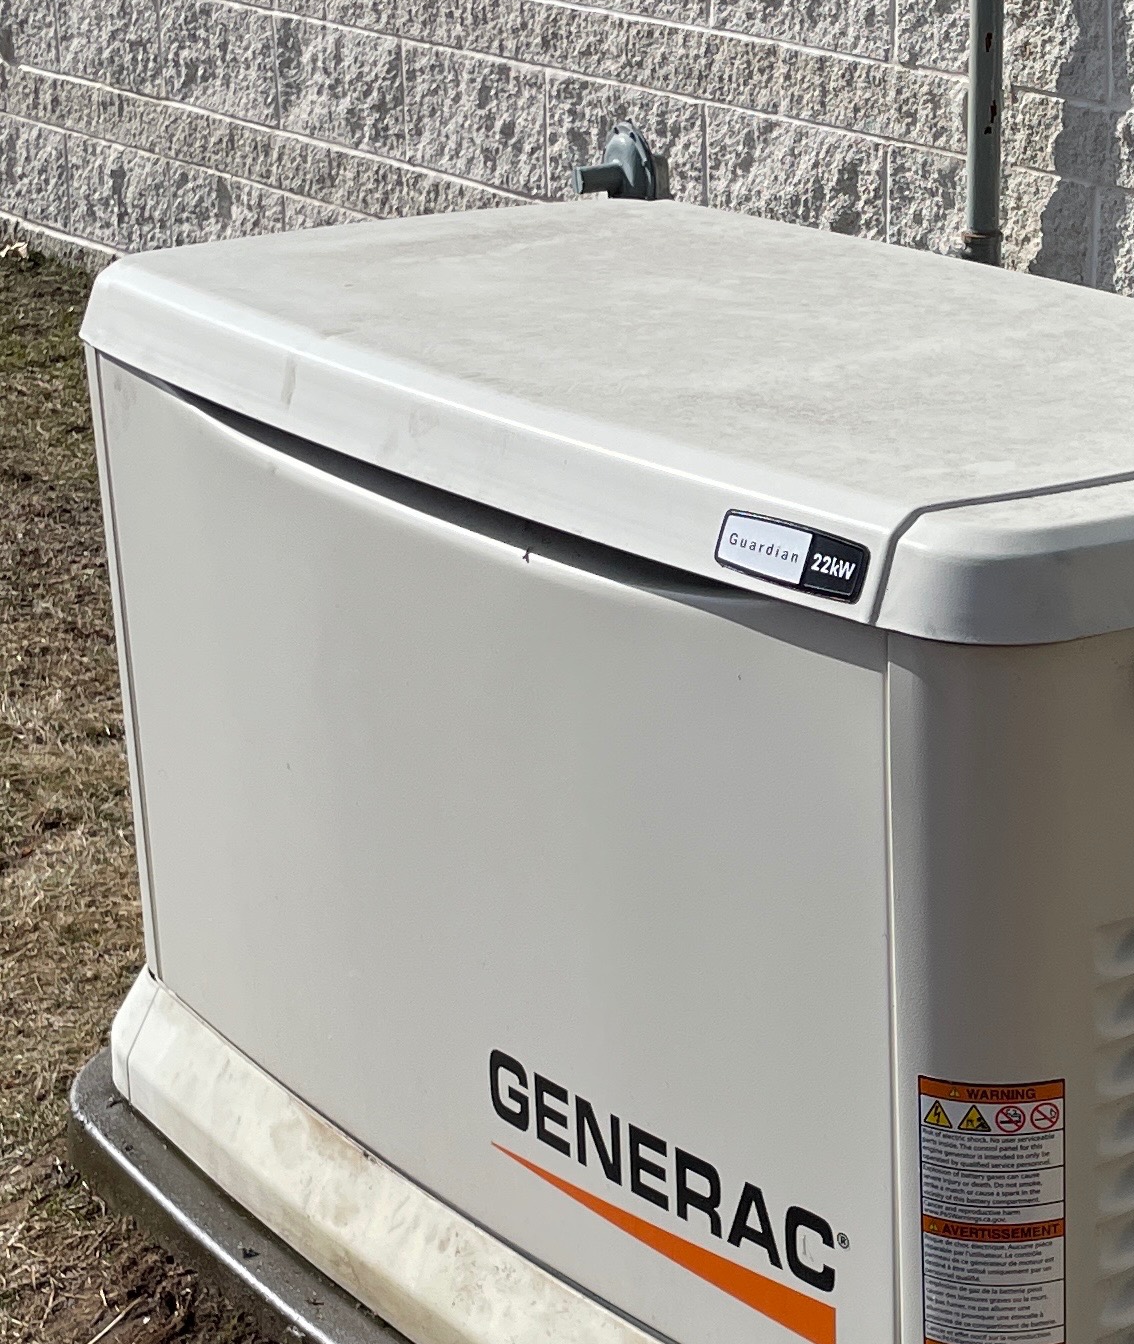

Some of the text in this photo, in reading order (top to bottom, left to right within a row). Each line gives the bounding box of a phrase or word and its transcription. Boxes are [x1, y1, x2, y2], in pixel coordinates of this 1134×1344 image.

[728, 532, 857, 581] Guardian 22kW
[966, 1088, 1036, 1100] WARNING
[942, 1223, 1060, 1240] AVERTISSEMENT
